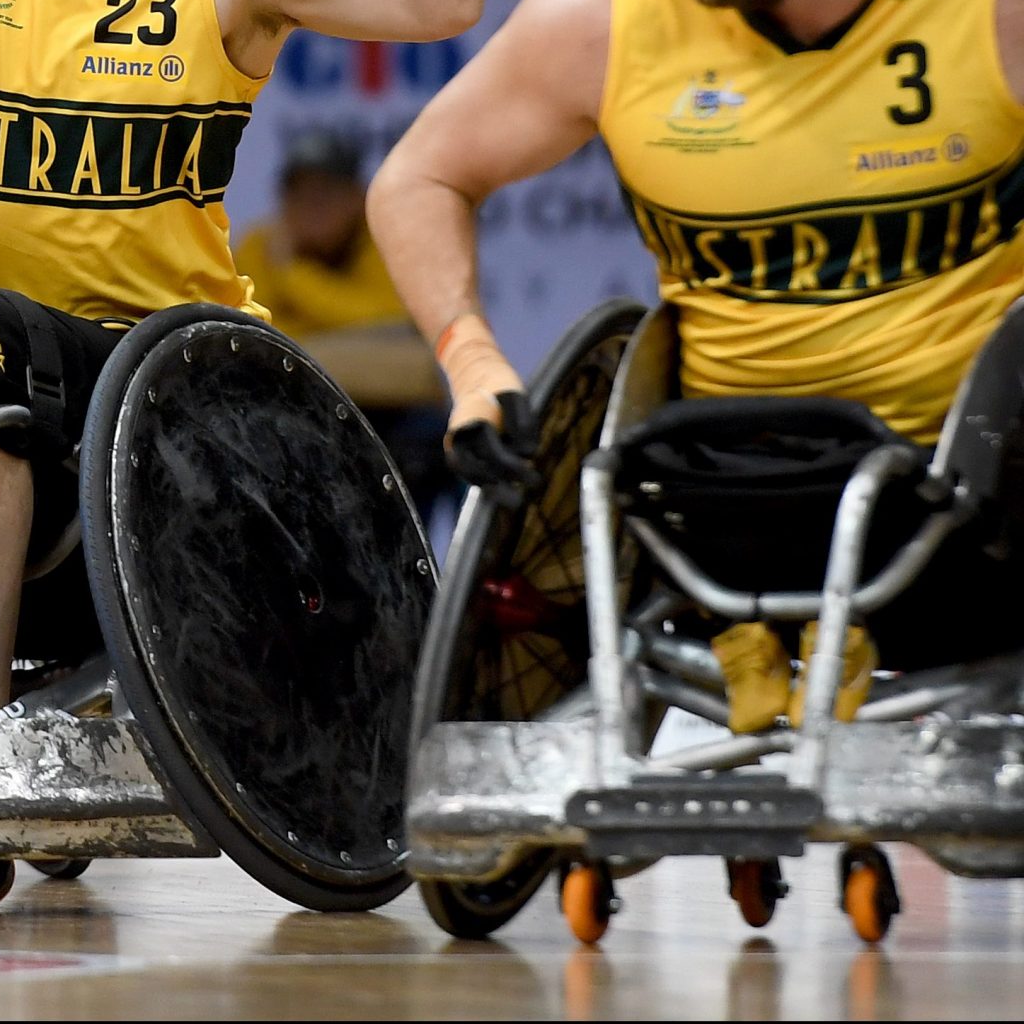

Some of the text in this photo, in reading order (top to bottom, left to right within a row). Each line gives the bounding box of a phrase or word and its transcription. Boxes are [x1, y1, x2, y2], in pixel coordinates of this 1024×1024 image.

[81, 56, 153, 77] Allianz
[886, 40, 932, 125] 3
[857, 147, 937, 173] Allianz
